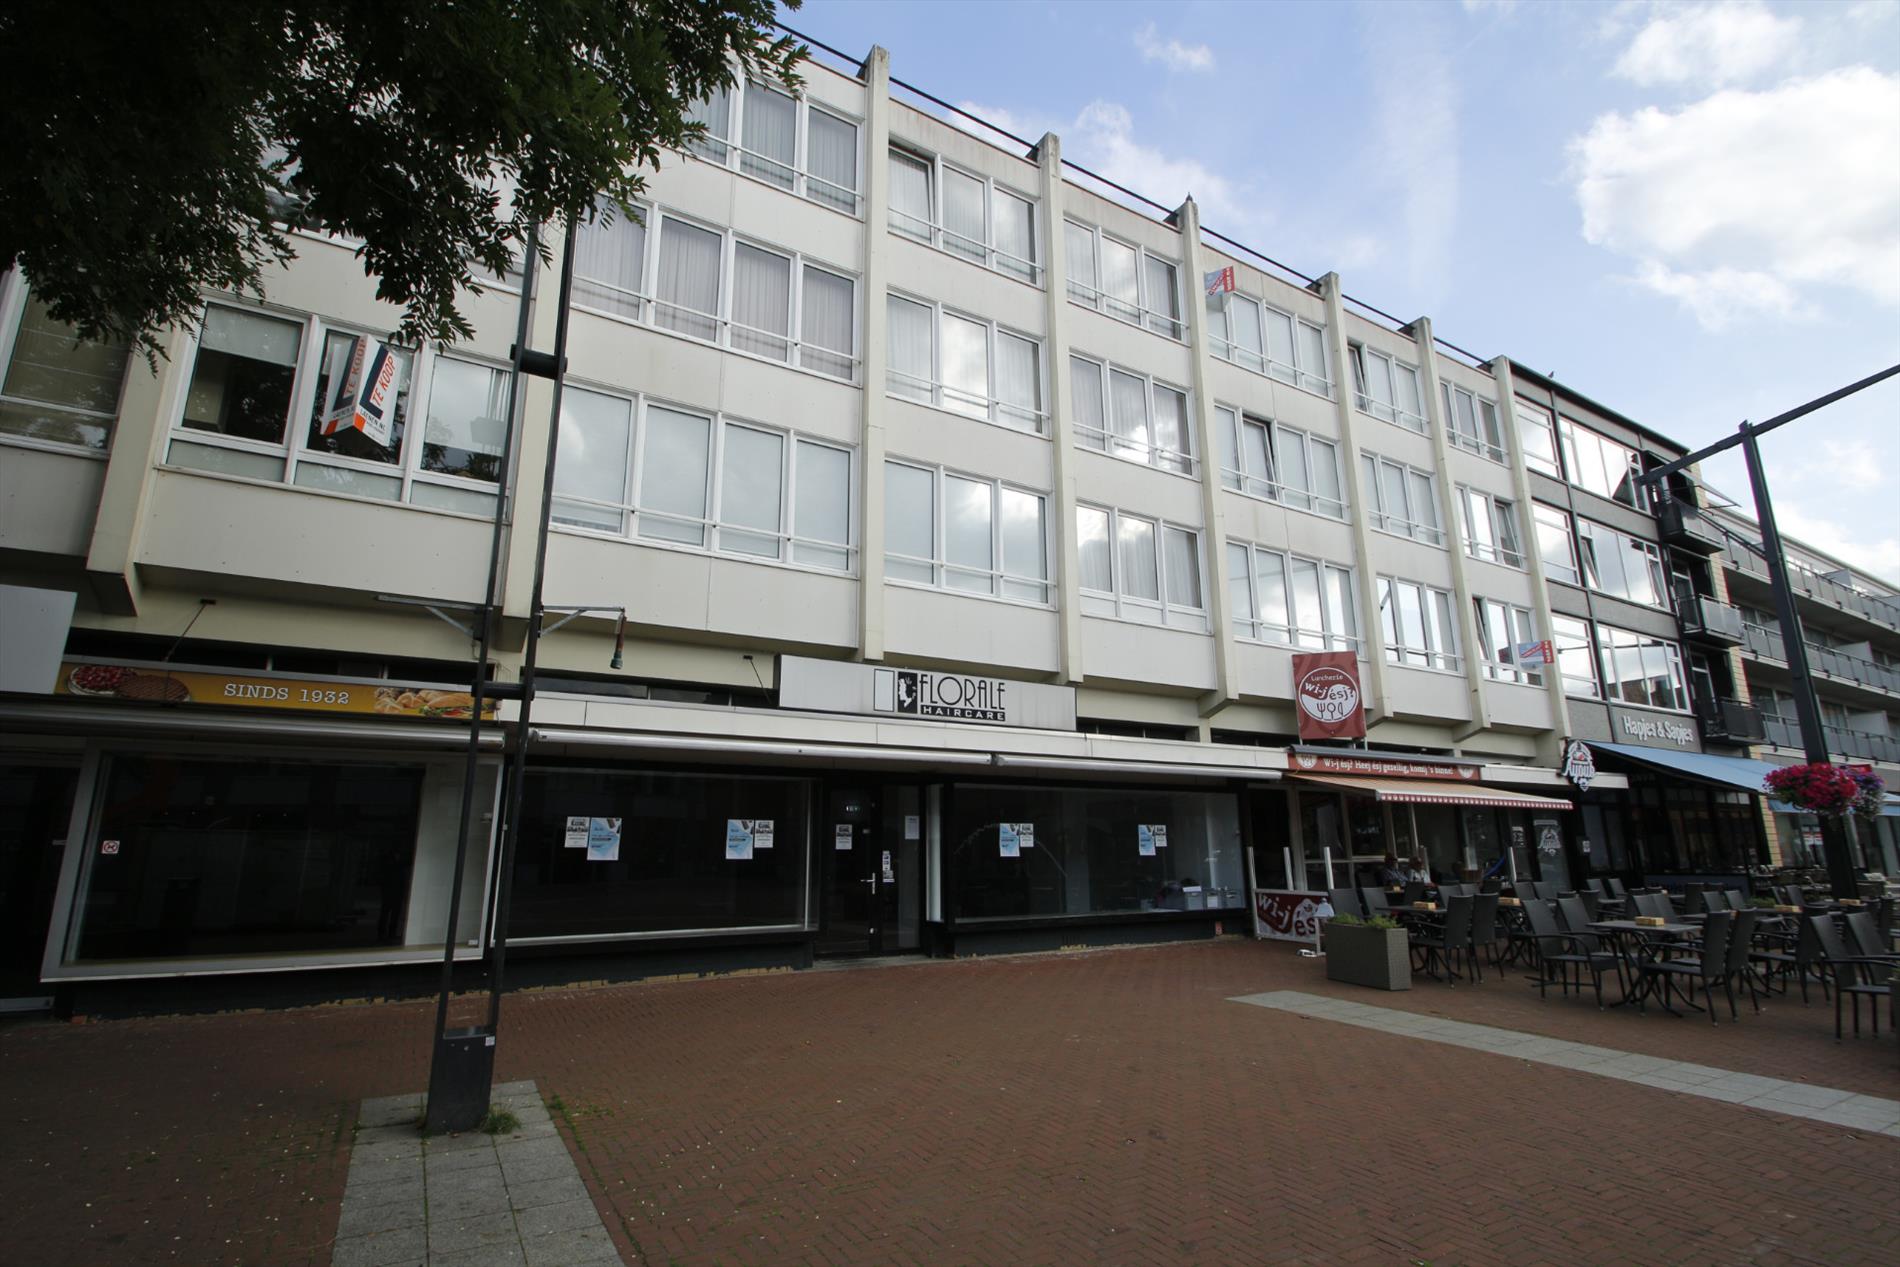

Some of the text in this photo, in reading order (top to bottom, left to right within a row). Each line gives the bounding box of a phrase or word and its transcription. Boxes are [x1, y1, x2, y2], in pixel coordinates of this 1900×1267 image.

[373, 387, 385, 406] TE
[379, 356, 396, 392] KOOP
[223, 683, 350, 705] SINDS 1932
[919, 673, 1006, 710] FLORALE
[923, 705, 1005, 721] HAIRCARE
[1622, 715, 1694, 746] Hapjes & Sapjes
